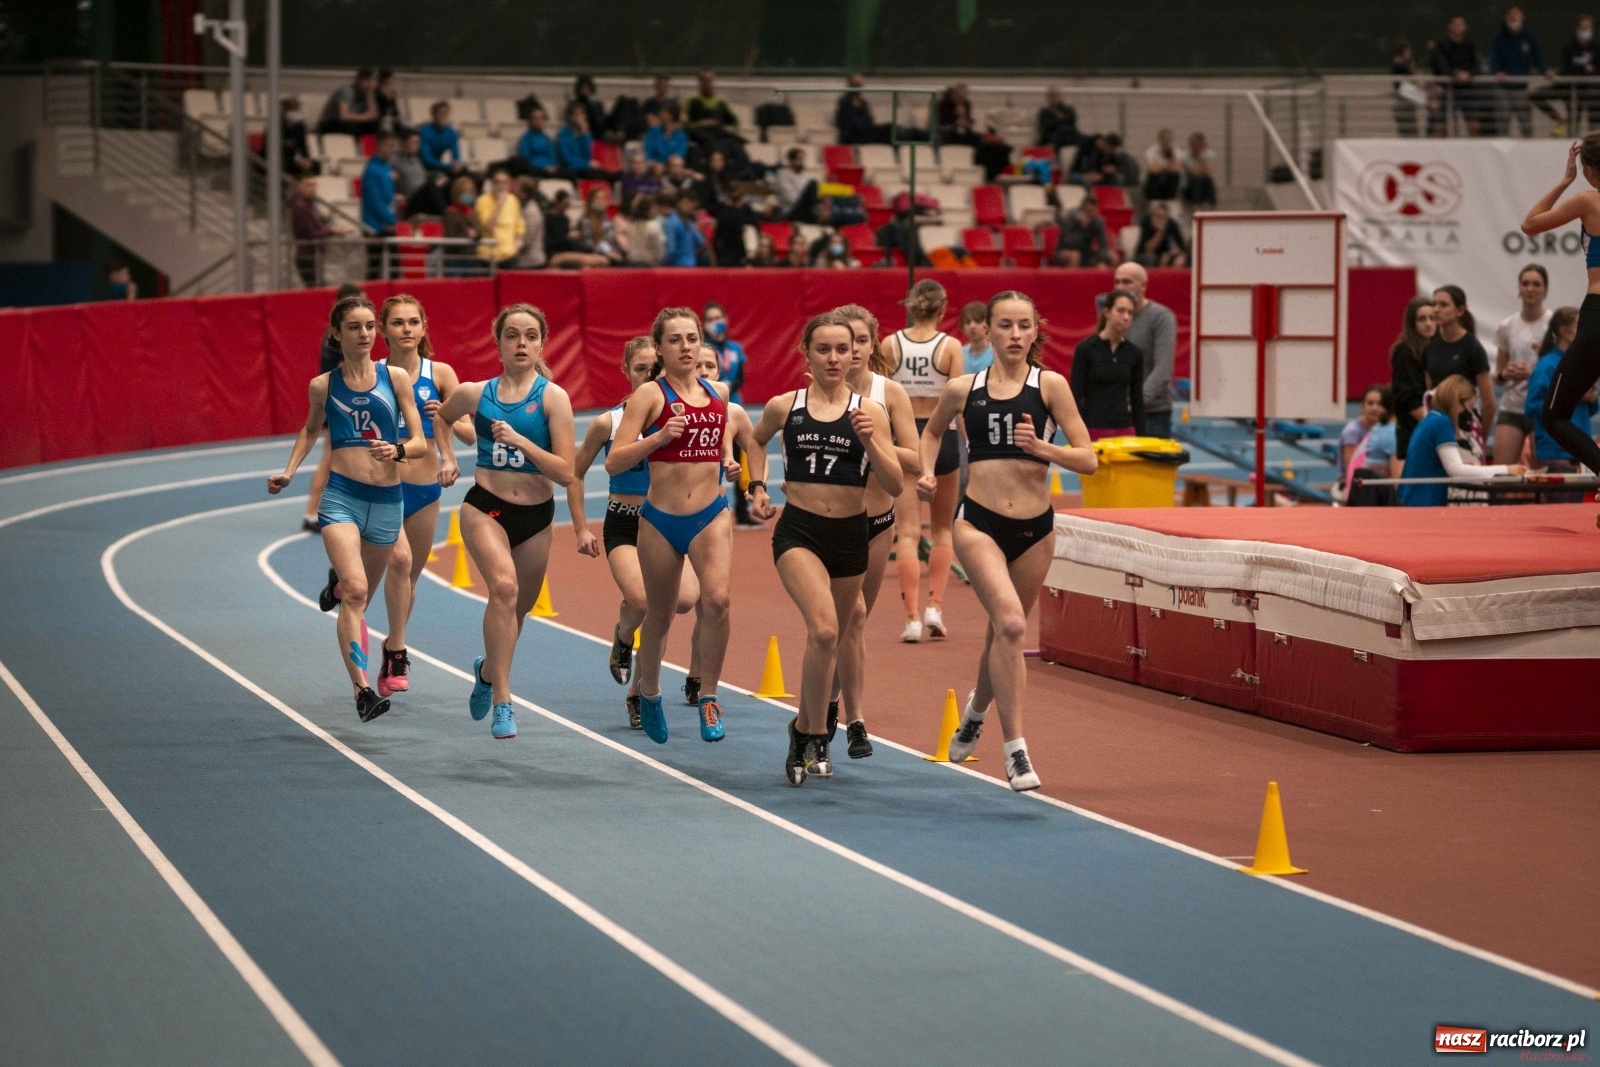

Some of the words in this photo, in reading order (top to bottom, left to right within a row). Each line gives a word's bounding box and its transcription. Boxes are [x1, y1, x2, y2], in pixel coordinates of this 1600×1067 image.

[906, 357, 929, 376] 42
[352, 410, 371, 430] 12
[684, 412, 723, 425] PIAST
[988, 412, 1013, 445] 51
[688, 427, 720, 447] 768
[797, 433, 819, 442] MKS
[830, 435, 851, 446] SMS
[493, 442, 525, 468] 63
[805, 452, 838, 475] 17
[874, 512, 891, 525] NIKE
